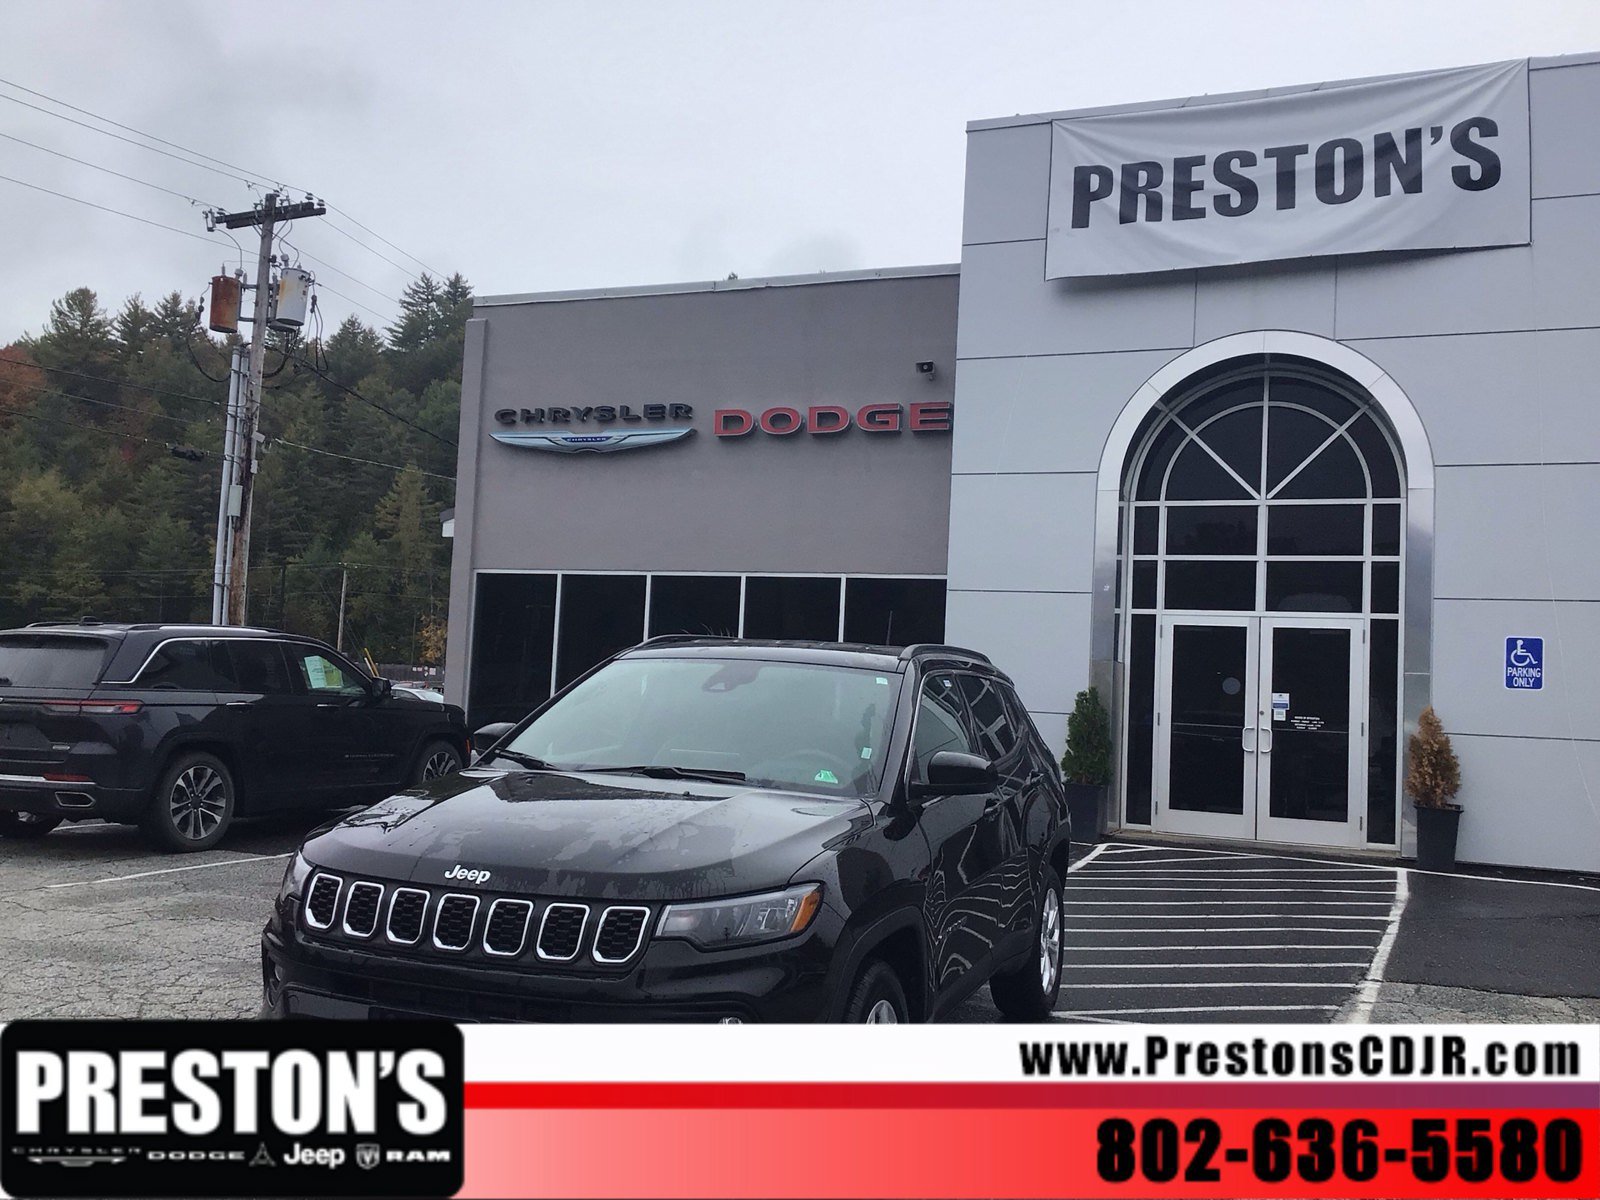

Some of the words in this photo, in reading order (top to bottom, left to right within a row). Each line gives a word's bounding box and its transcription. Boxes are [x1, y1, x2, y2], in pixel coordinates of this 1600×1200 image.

[1071, 116, 1502, 229] PRESTON'S
[494, 402, 694, 425] CHRYSLER
[713, 401, 951, 438] DODGE
[1507, 667, 1541, 678] PARKING
[1512, 677, 1535, 687] ONLY
[444, 864, 491, 885] Jeep
